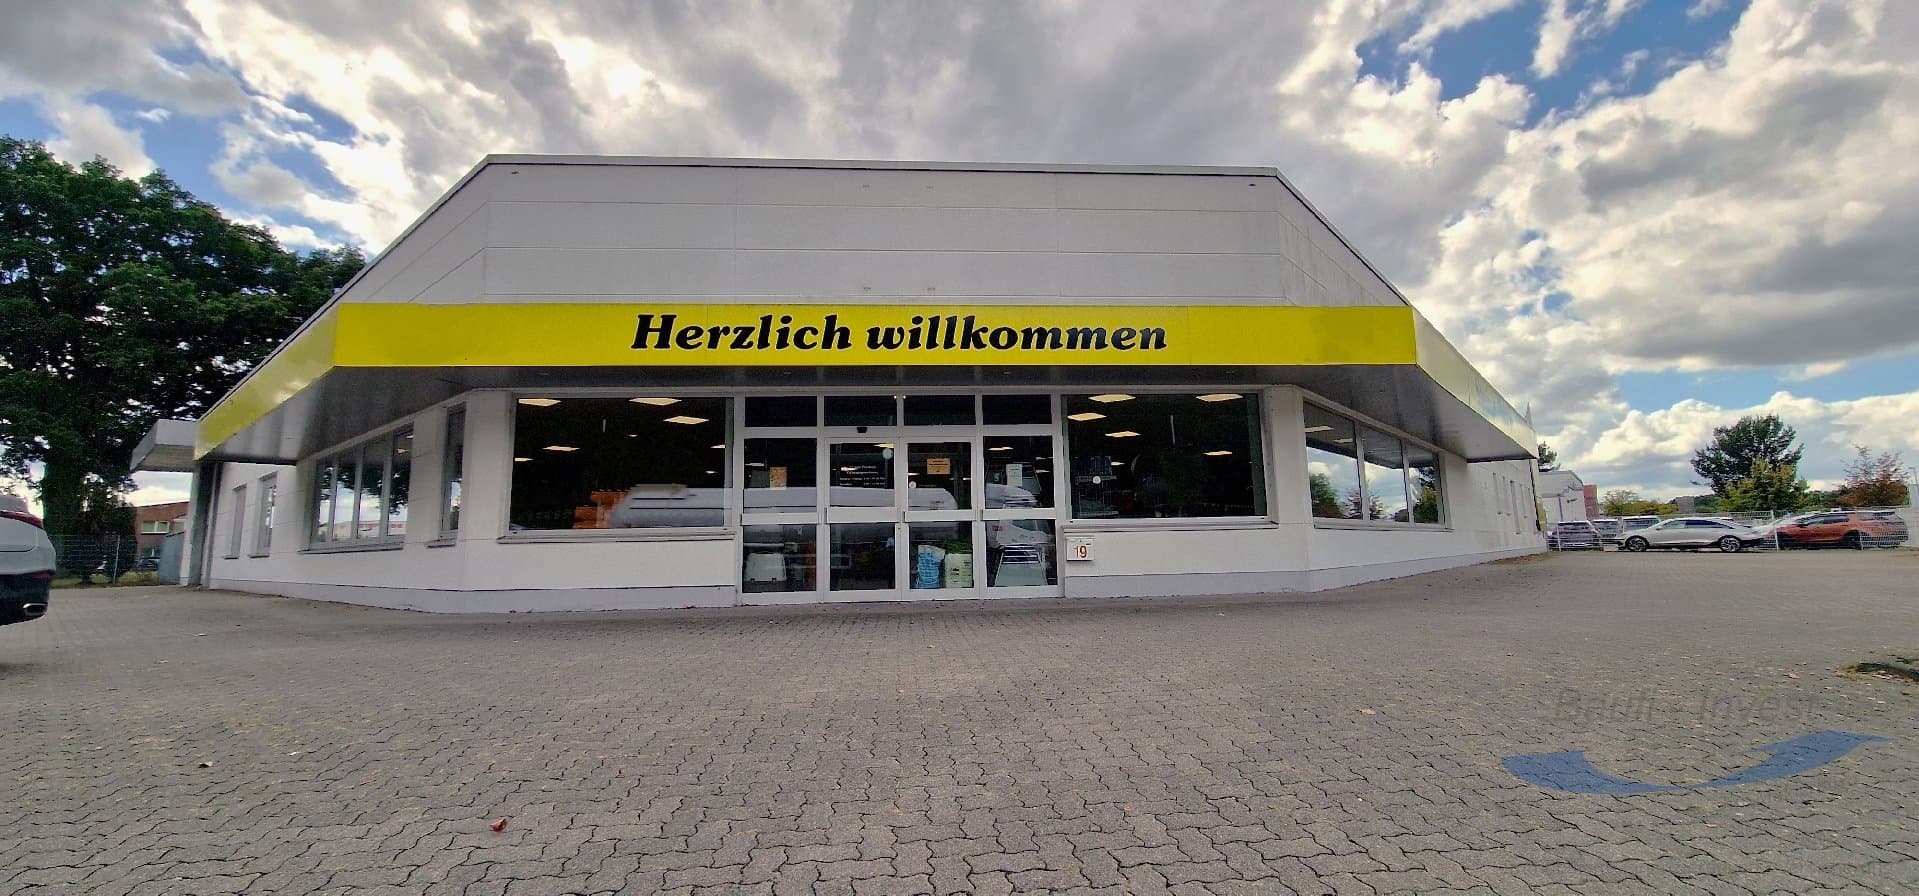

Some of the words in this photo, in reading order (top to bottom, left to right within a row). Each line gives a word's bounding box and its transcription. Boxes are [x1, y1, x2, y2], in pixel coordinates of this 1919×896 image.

[631, 313, 851, 351] Herzlich
[866, 314, 1168, 351] willkommen
[1073, 545, 1087, 559] 19
